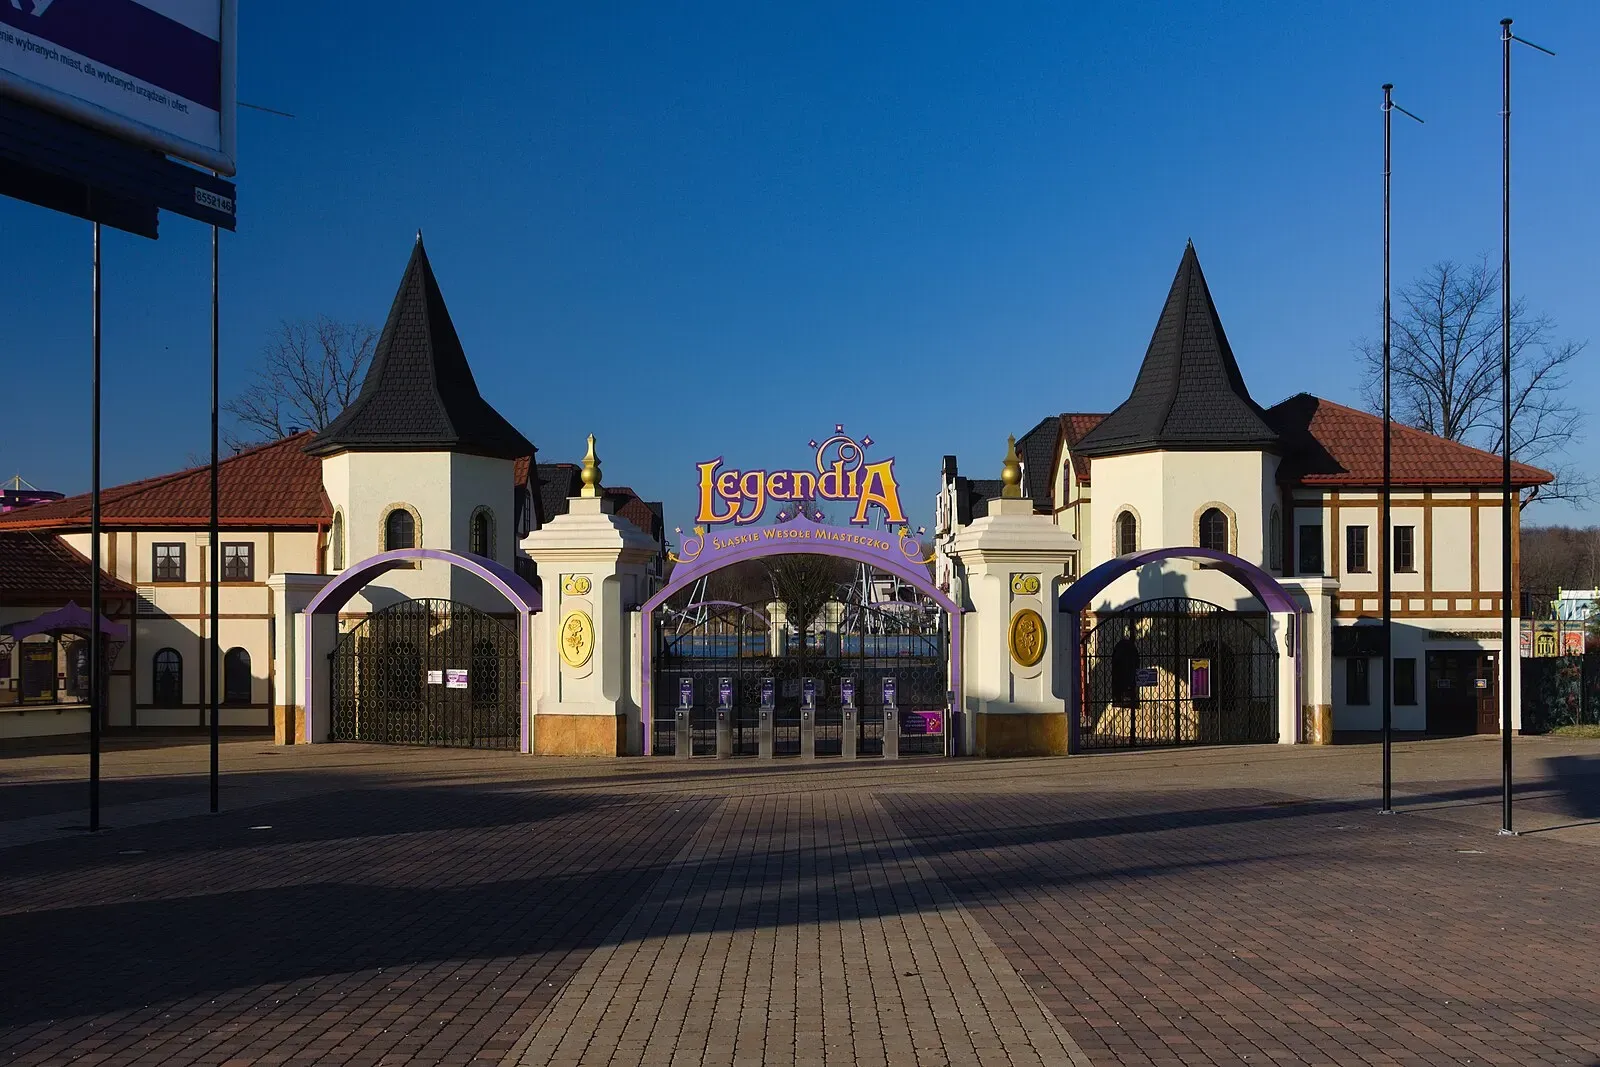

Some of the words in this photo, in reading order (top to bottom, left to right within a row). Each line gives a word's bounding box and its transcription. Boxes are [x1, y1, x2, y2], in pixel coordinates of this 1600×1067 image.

[15, 37, 59, 61] wybranych
[60, 55, 82, 72] miast,
[84, 63, 96, 77] dla
[97, 70, 135, 93] wybranych
[712, 531, 760, 550] ŚLĄSKIE
[763, 528, 811, 540] WESOŁE
[814, 528, 890, 550] MIASTECZKO
